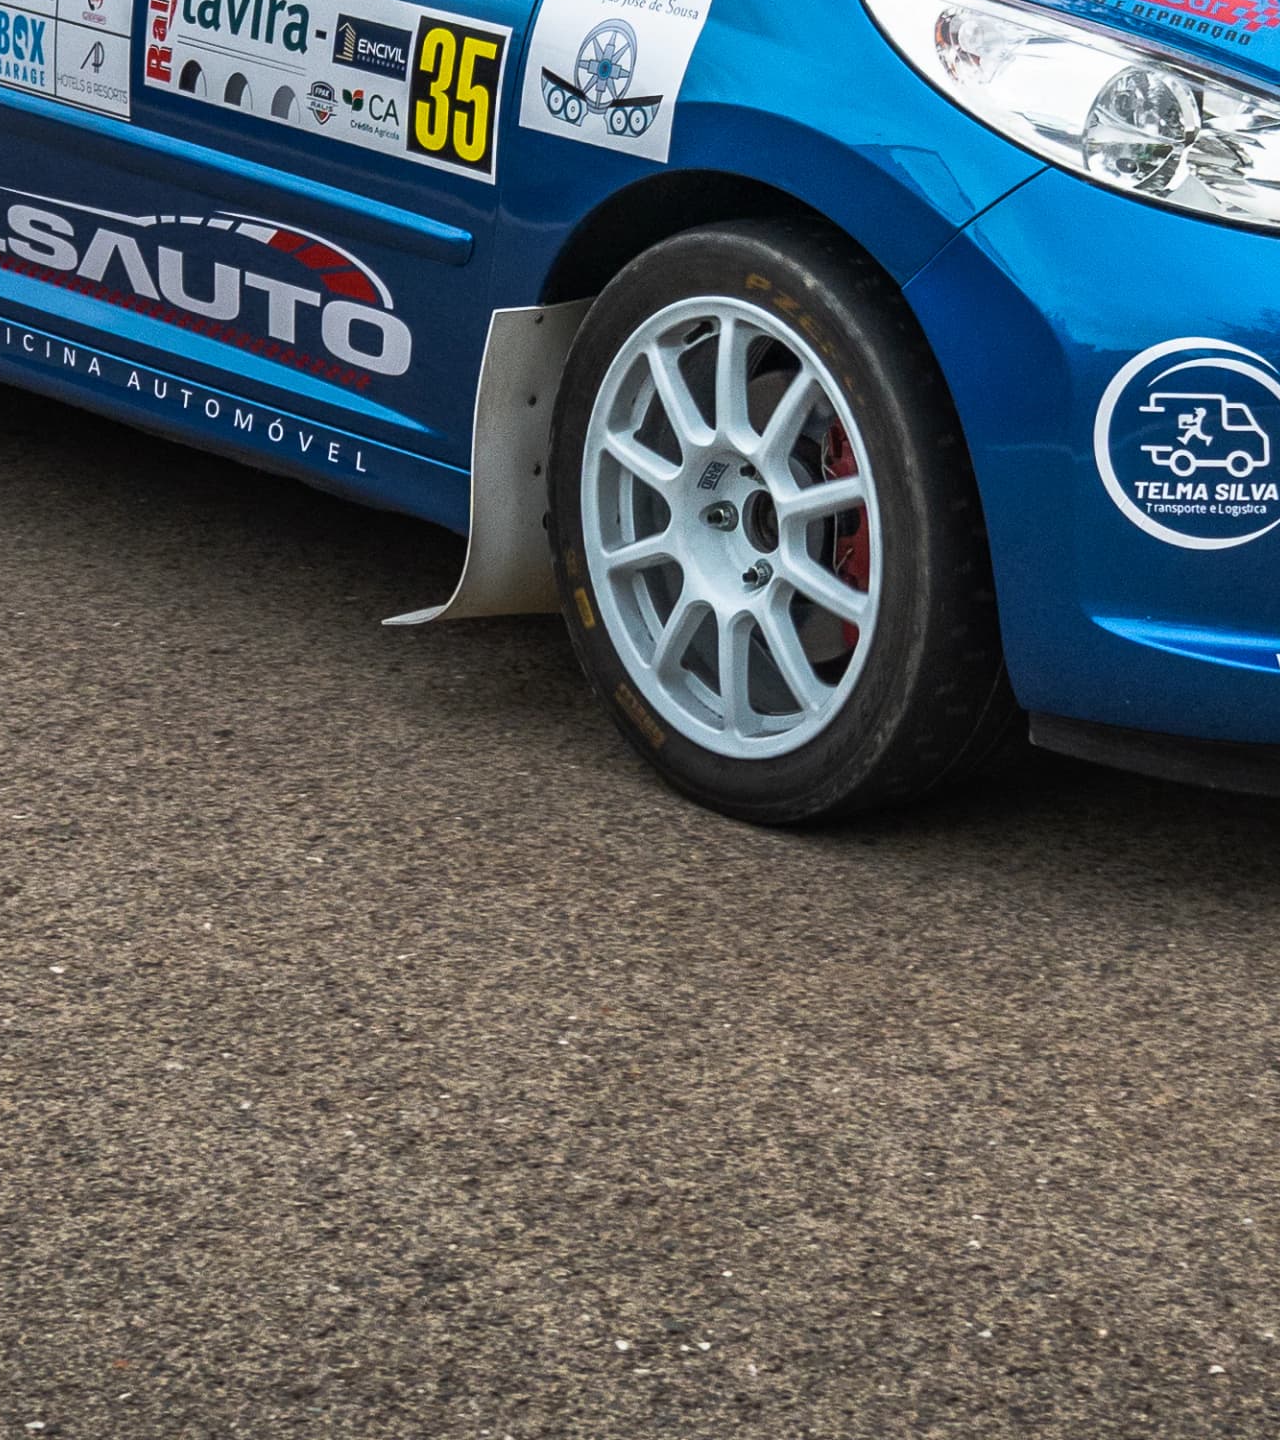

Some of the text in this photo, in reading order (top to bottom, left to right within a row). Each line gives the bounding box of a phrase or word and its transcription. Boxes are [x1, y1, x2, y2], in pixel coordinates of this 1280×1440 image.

[357, 38, 406, 64] ENCIVIL
[414, 27, 498, 163] 35
[368, 94, 400, 127] CA
[126, 368, 368, 474] AUTOMÓVEL
[1134, 480, 1279, 502] TELMA SILVA
[1145, 502, 1207, 516] Transporte
[1209, 506, 1217, 514] e
